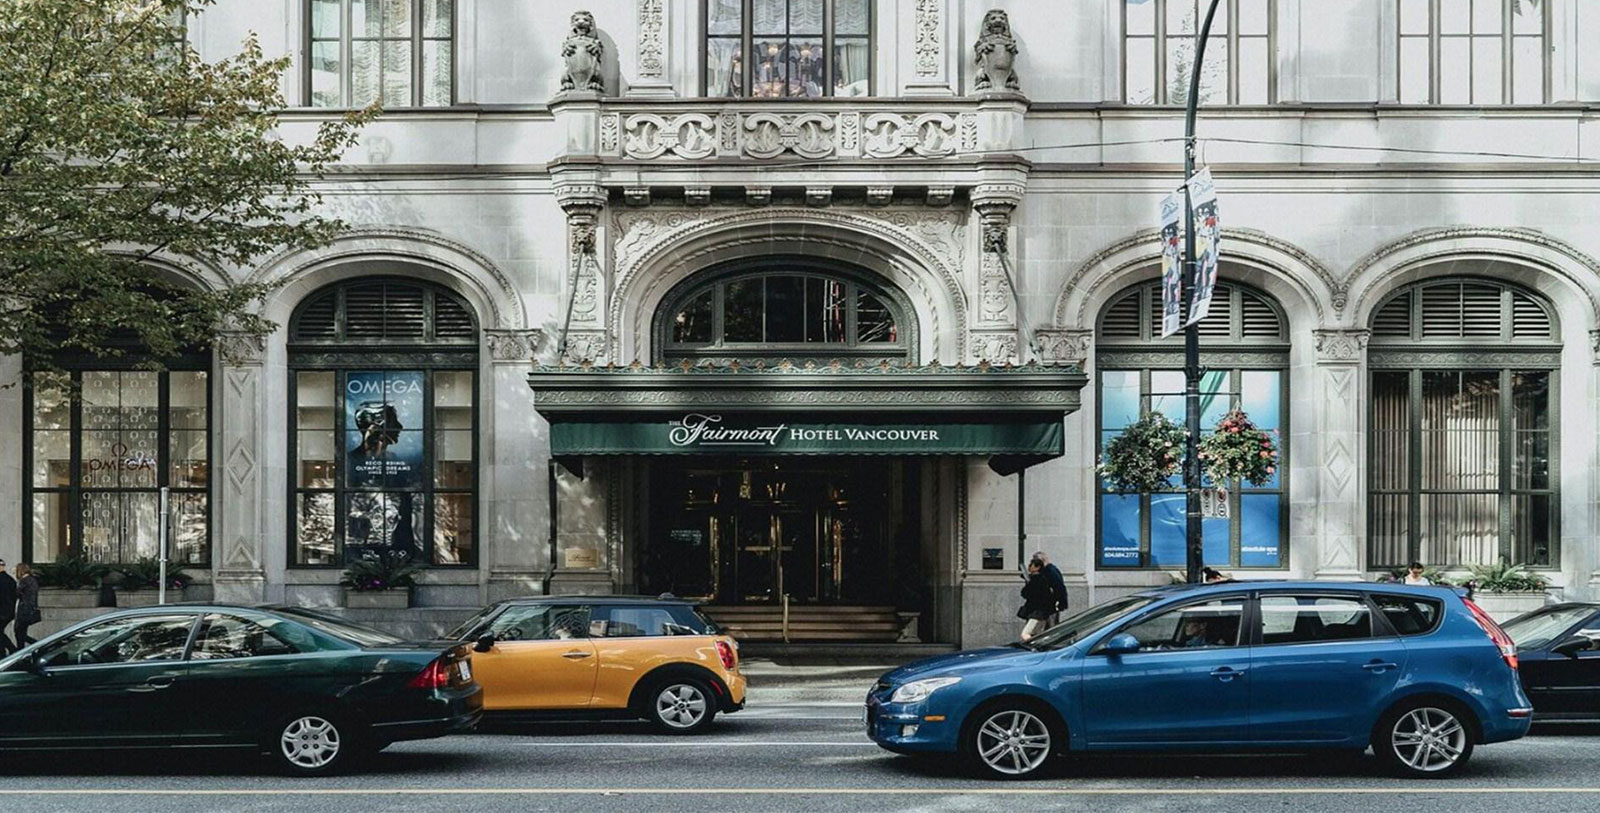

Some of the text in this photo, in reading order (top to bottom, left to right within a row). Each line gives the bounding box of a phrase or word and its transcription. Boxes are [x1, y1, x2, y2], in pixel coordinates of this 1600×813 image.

[347, 380, 422, 394] OMEGA
[669, 413, 788, 446] Fairmont
[790, 428, 842, 440] HOTEL
[844, 428, 940, 440] VANCOUVER
[90, 459, 151, 471] OMEGA
